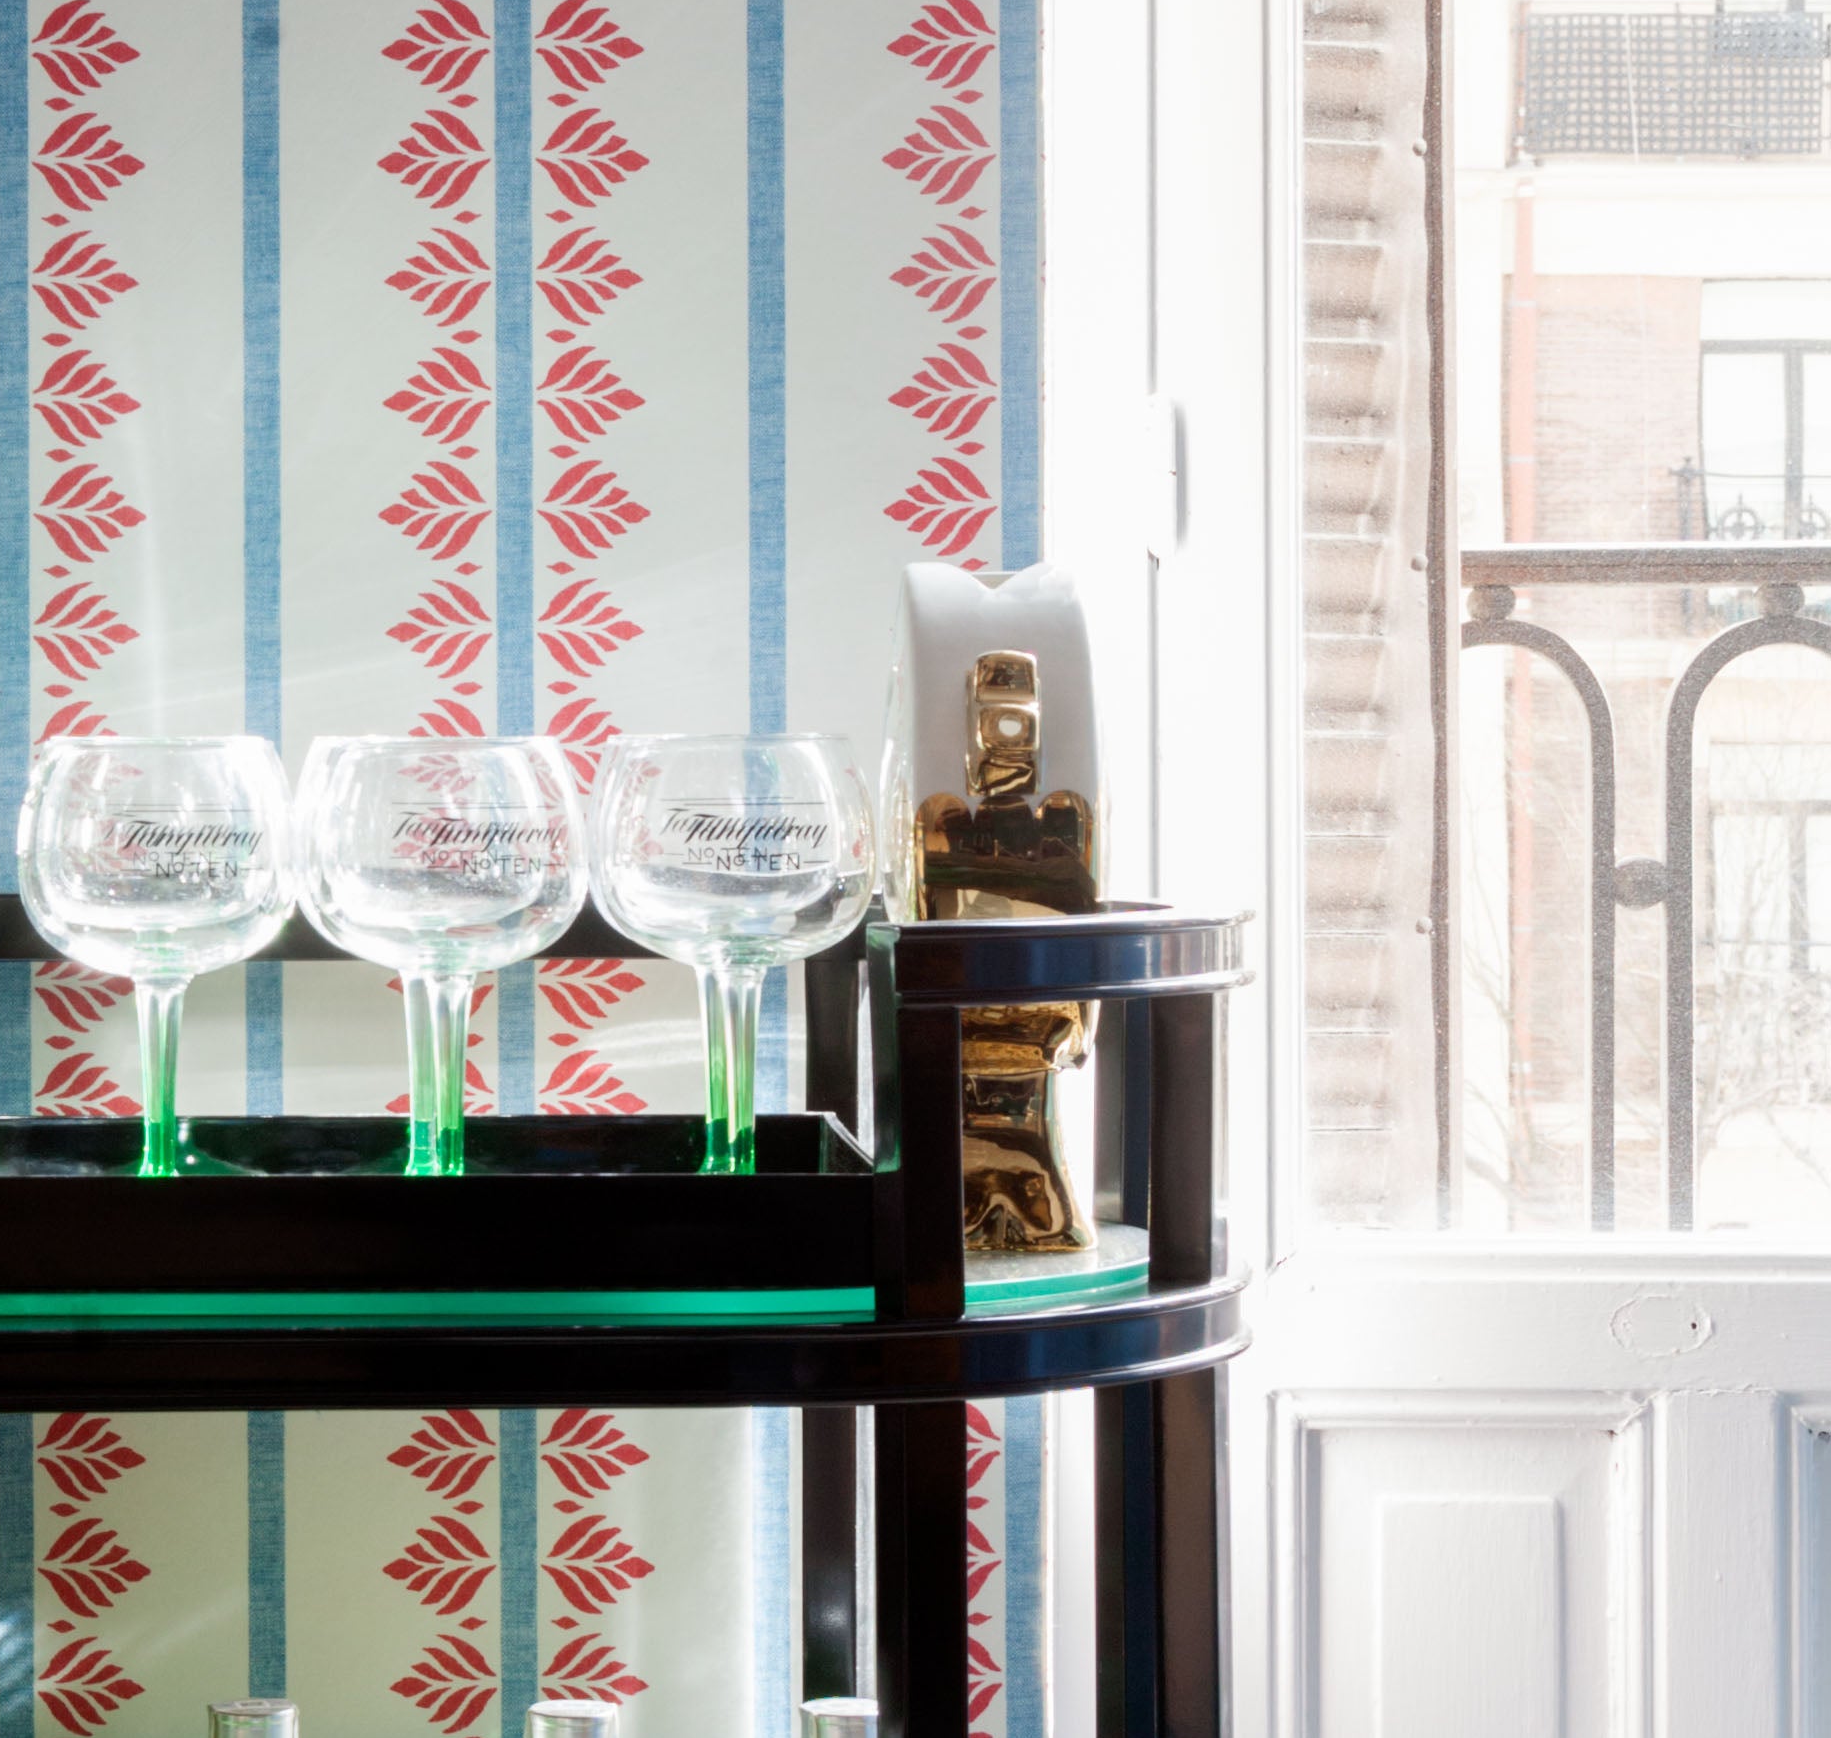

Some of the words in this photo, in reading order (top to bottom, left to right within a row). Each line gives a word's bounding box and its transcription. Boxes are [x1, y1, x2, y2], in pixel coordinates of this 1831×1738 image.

[190, 860, 238, 878] TEN
[499, 857, 542, 875] TEN
[750, 854, 801, 872] TEN
